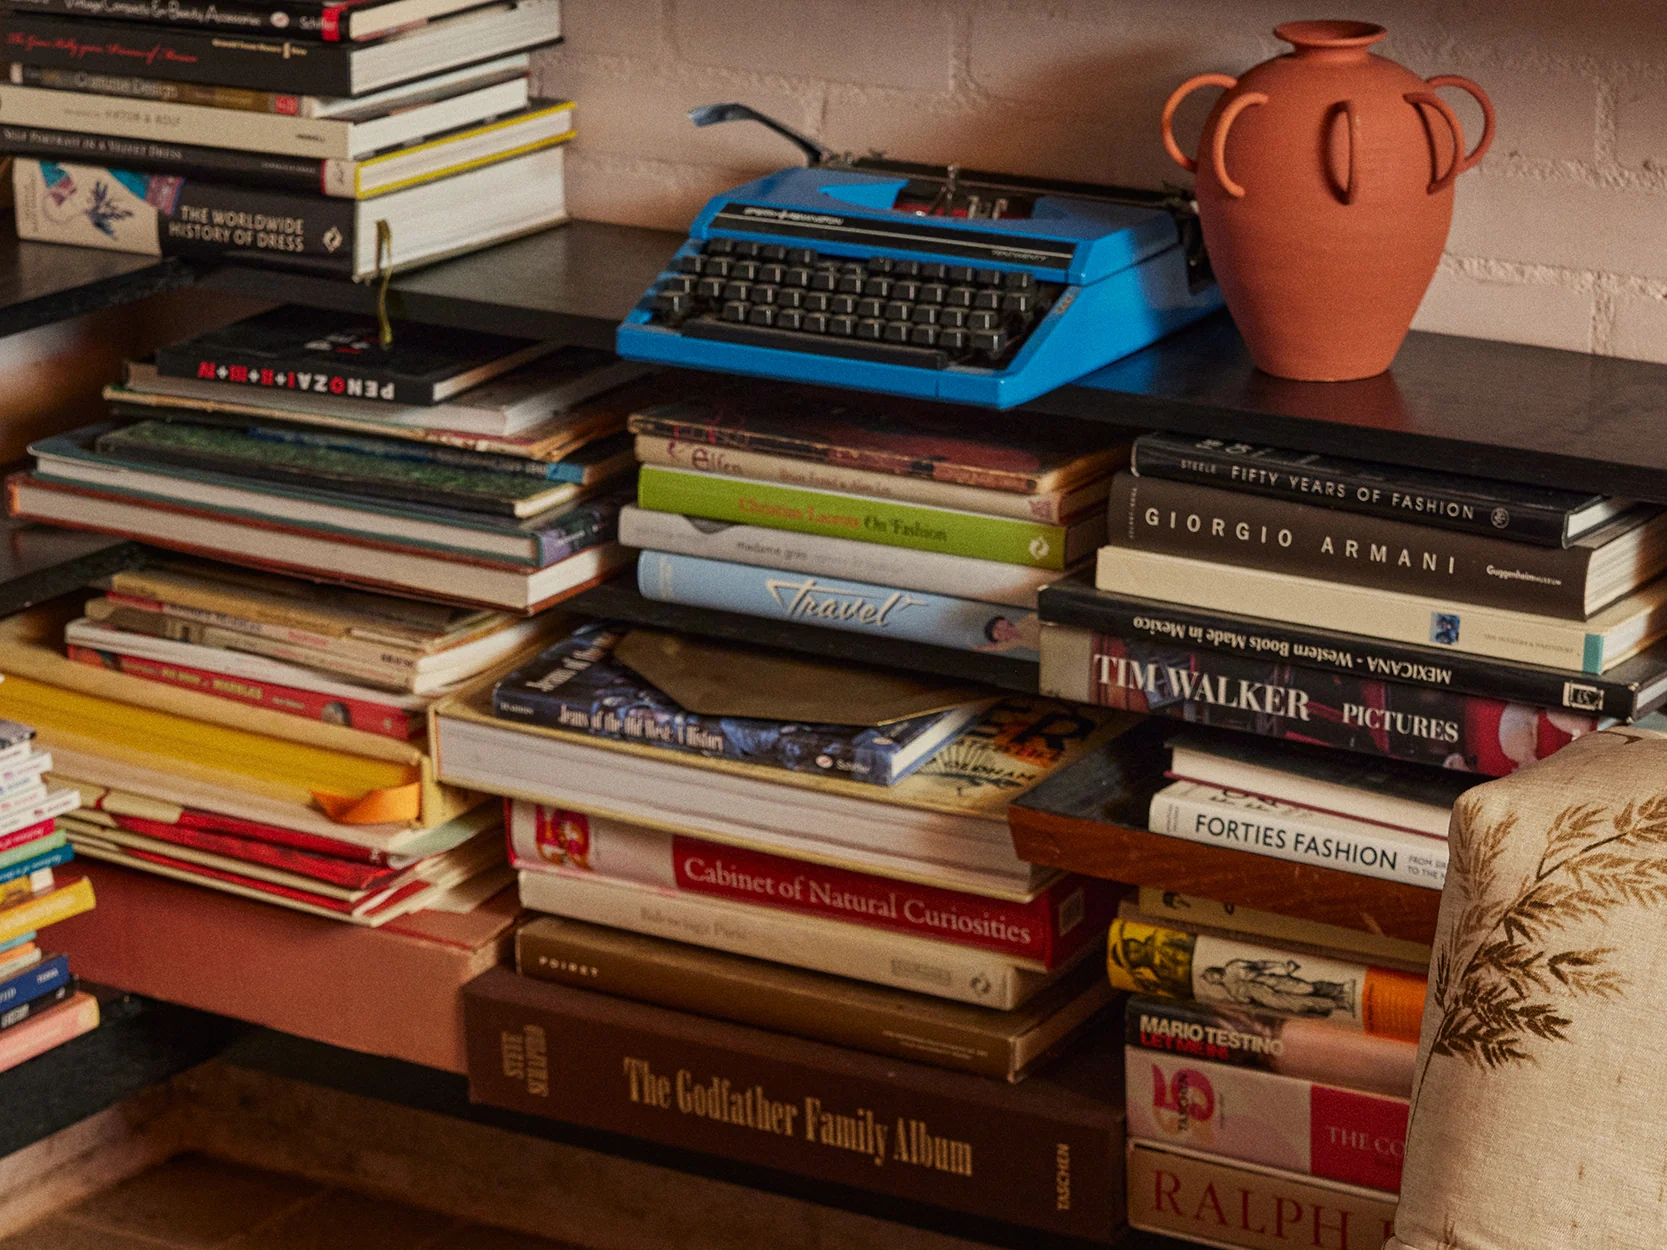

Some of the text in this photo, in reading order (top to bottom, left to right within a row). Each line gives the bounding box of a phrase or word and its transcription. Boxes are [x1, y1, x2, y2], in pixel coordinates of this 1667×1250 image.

[181, 205, 304, 235] THE WORLDWIDE
[168, 221, 304, 252] HISTORY OF DRESS
[692, 447, 743, 474] Elfen
[1180, 459, 1475, 521] STEELE FIFTY YEARS OF FASHION
[739, 496, 947, 543] Christian Lacroix On Fashion
[1144, 507, 1456, 575] GIORGIO ARMANI
[766, 578, 928, 629] Travel
[1132, 615, 1187, 639] Mexico
[1188, 625, 1205, 644] in
[1205, 626, 1246, 648] Made
[1249, 636, 1290, 658] Boots
[1292, 642, 1354, 669] Western
[1366, 655, 1453, 685] MEXICANA
[1093, 653, 1460, 744] TIM WALKER PICTURES
[558, 704, 590, 729] Jeans
[591, 709, 604, 730] of
[604, 710, 623, 733] the
[624, 716, 644, 738] Old
[686, 725, 724, 754] History
[1194, 813, 1287, 849] FORTIES
[1294, 833, 1398, 871] FASHION
[1408, 855, 1432, 866] FROM
[1408, 865, 1438, 880] TO THE
[683, 855, 1032, 945] Cabinet of Natural Curiosities
[538, 954, 599, 979] POIRET
[1139, 1014, 1285, 1057] MARIO TESTINO
[1139, 1030, 1174, 1050] LET
[1175, 1035, 1206, 1056] ME
[623, 1055, 973, 1178] The Godfather Family Album
[1325, 1125, 1370, 1152] THE
[1056, 1142, 1072, 1212] TASCHEN
